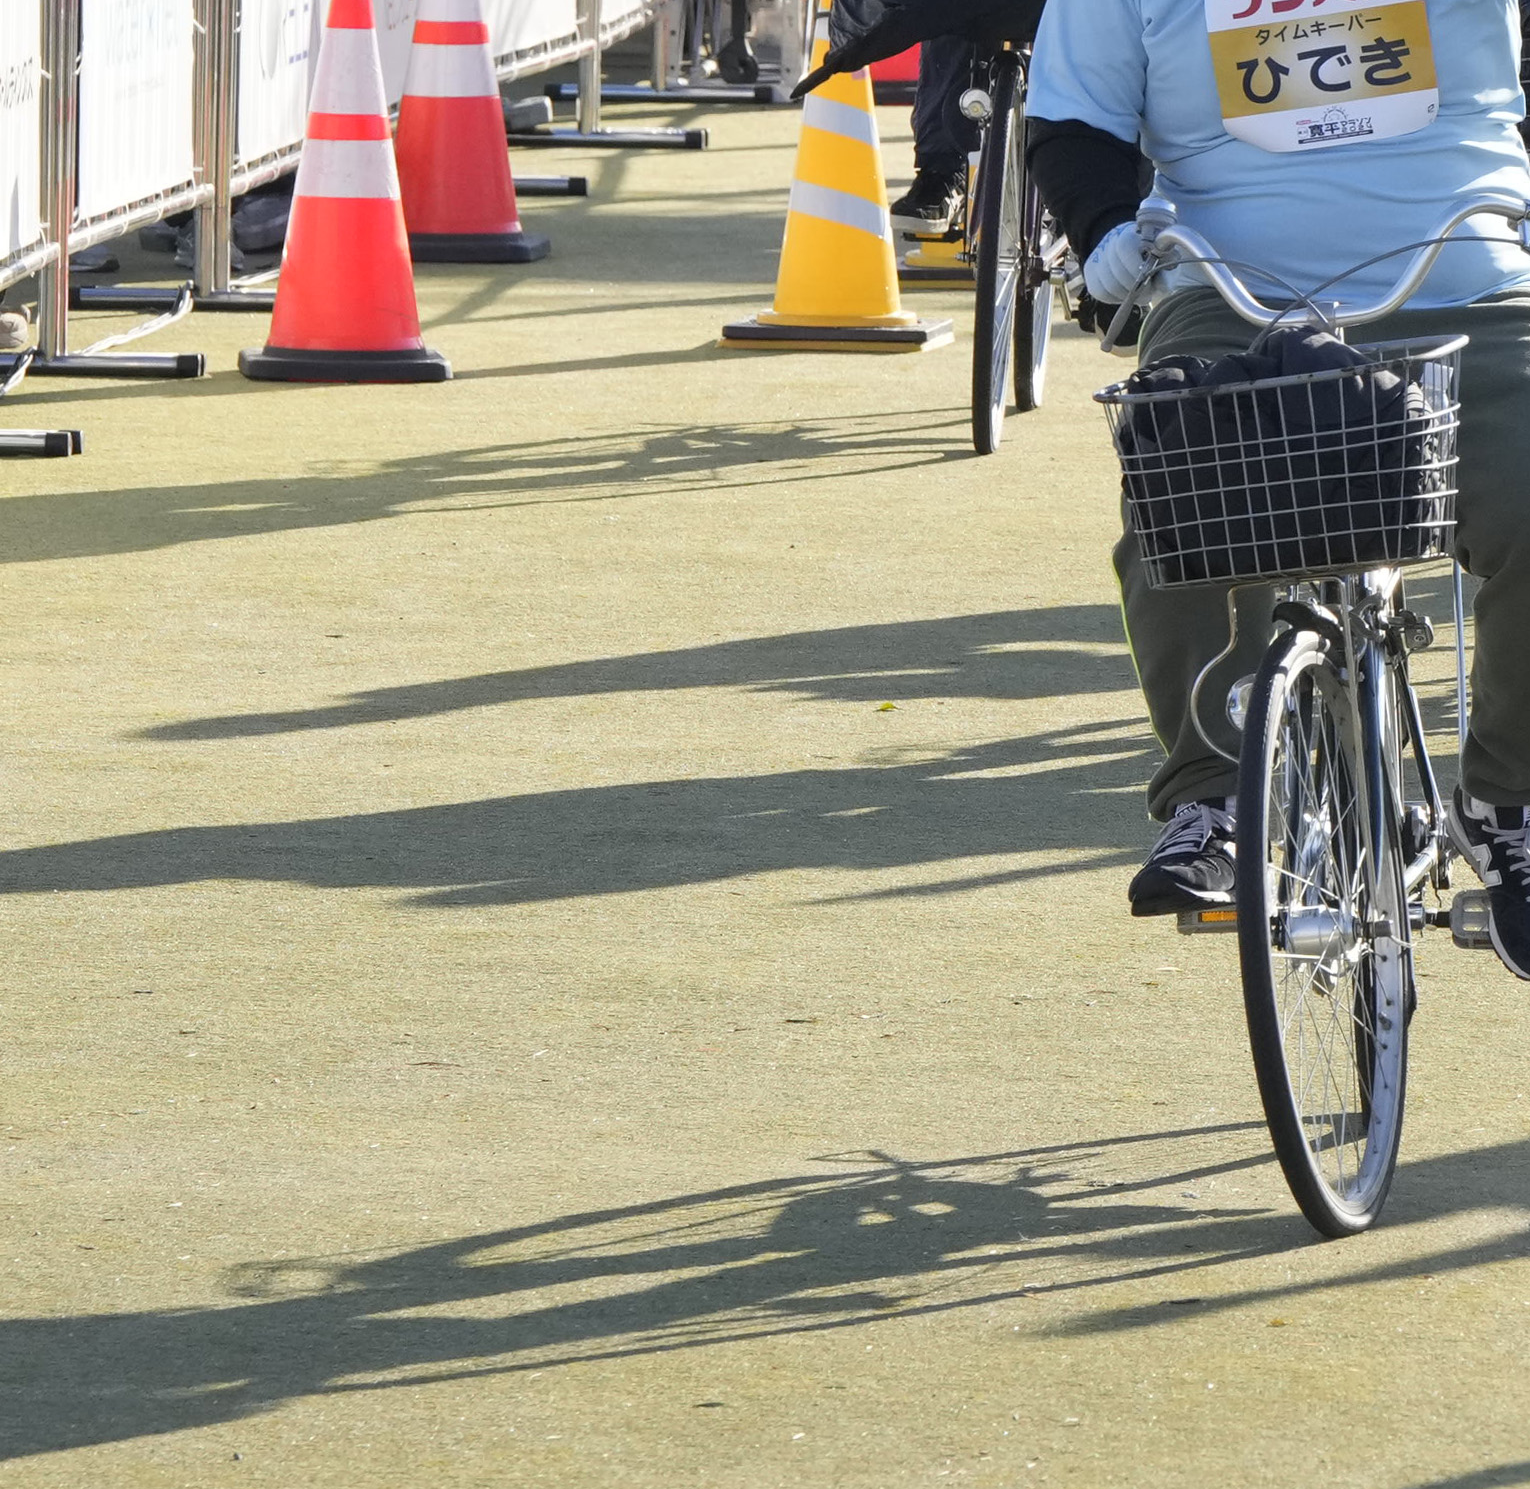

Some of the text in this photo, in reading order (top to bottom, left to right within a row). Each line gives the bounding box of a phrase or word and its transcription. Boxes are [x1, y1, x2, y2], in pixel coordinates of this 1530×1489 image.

[1254, 12, 1382, 46] タイムキーパー
[1235, 35, 1412, 105] ひでき
